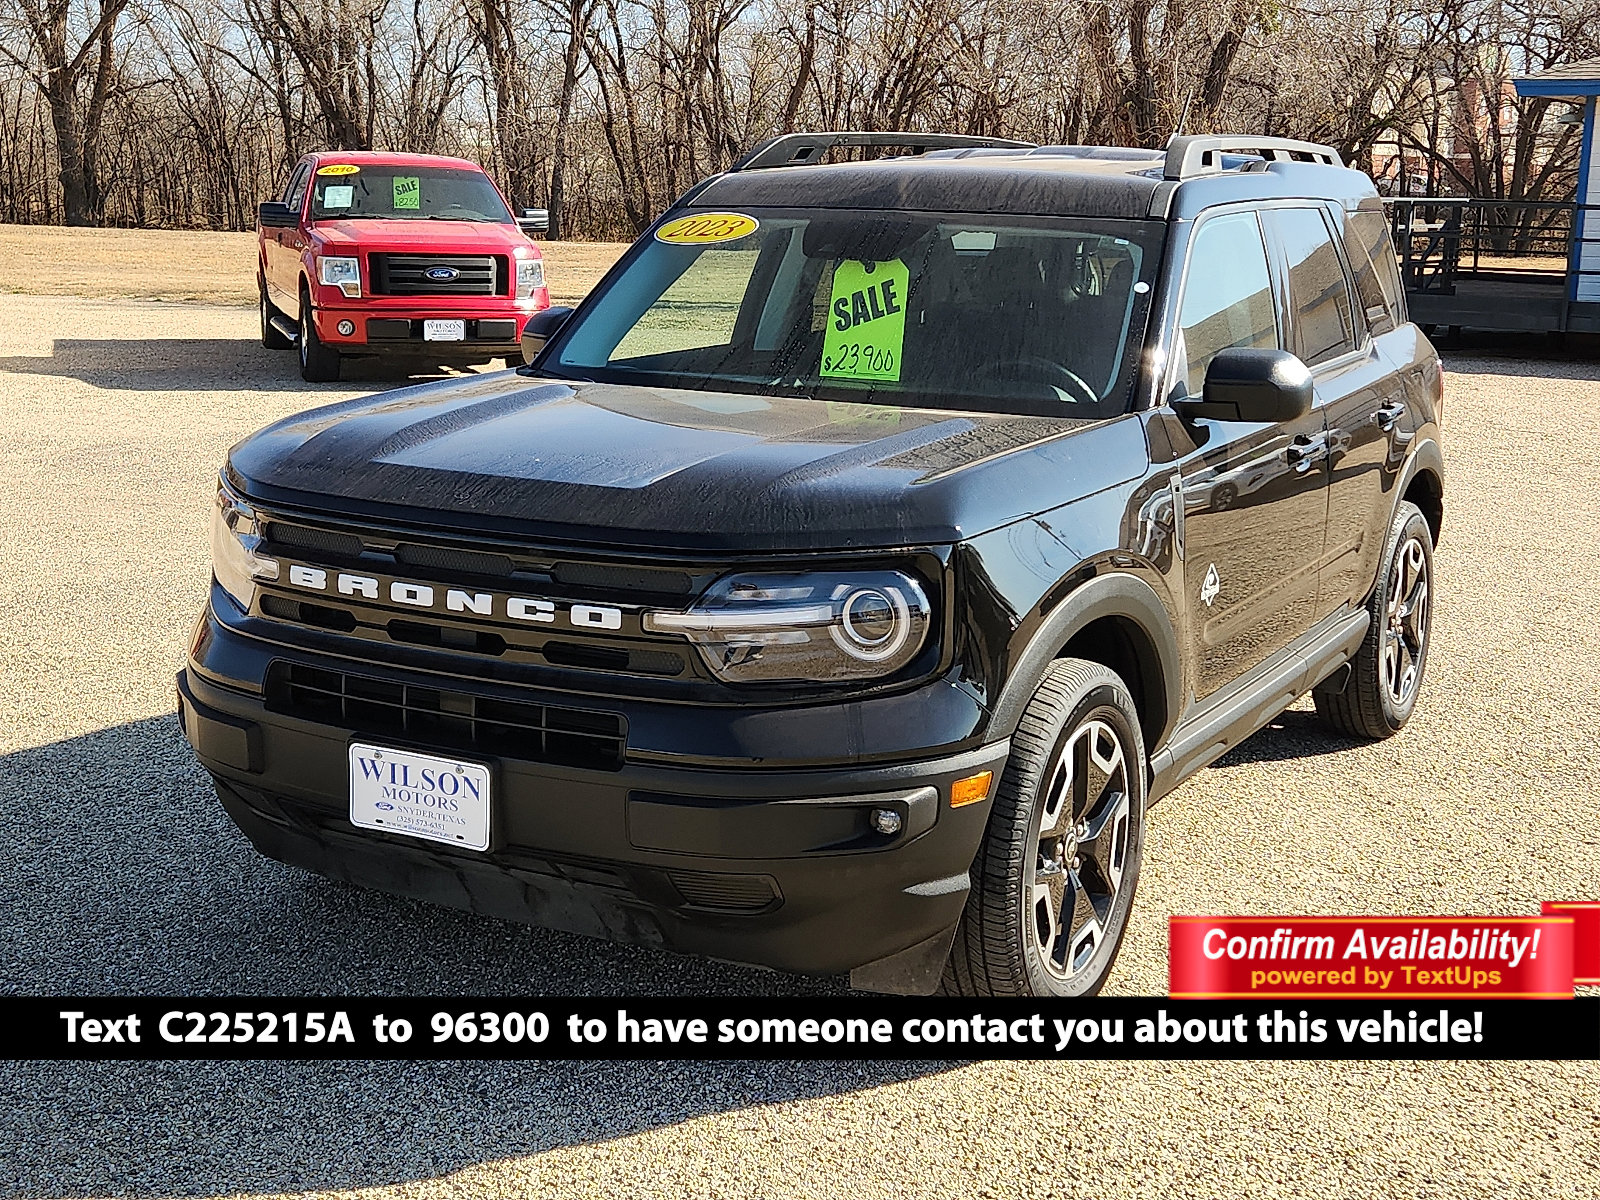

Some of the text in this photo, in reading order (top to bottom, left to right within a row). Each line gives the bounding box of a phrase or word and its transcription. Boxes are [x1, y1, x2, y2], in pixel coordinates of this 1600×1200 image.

[395, 180, 417, 195] SALE
[666, 219, 745, 238] 2023
[833, 278, 900, 332] SALE
[426, 322, 463, 330] WILSON
[824, 345, 894, 375] $23,900
[289, 565, 622, 631] BRONCO
[357, 757, 481, 802] WILSON
[382, 786, 459, 812] MOTORS
[396, 815, 445, 831] (325) 573-6351
